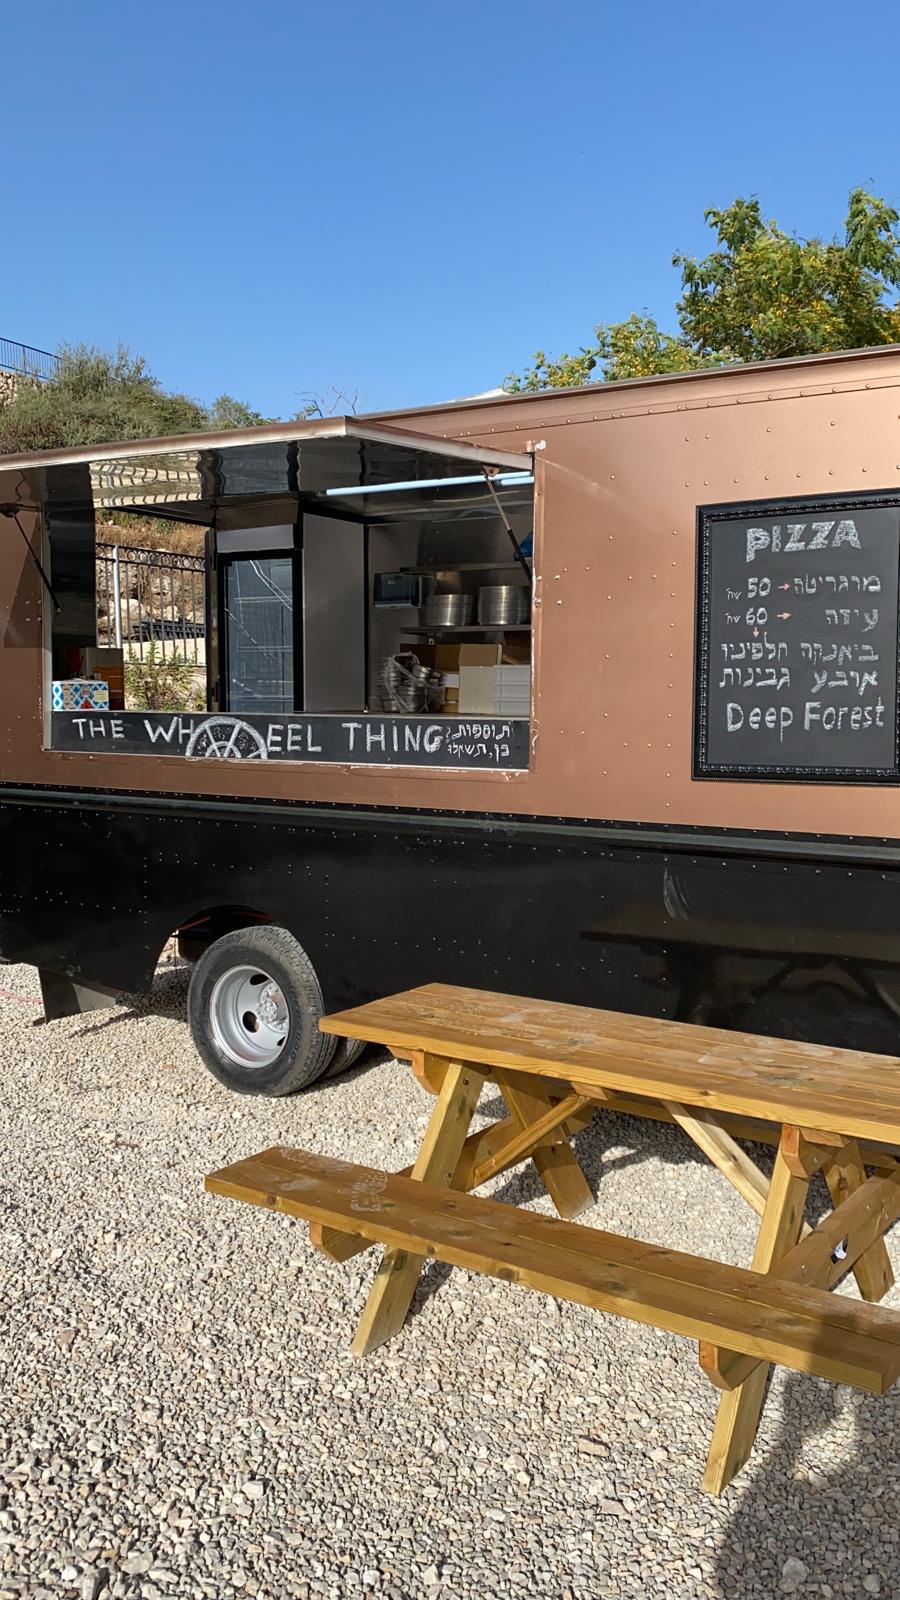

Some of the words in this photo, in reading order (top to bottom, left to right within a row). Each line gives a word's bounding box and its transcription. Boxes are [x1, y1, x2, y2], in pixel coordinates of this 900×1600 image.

[746, 519, 862, 563] PIZZA
[747, 577, 772, 599] 50
[794, 572, 881, 595] מרגריטה
[745, 607, 768, 626] 60
[719, 667, 791, 691] גבינות
[811, 670, 879, 696] ארבע
[726, 702, 794, 743] Deep
[804, 697, 885, 731] Forest
[72, 718, 126, 740] THE
[341, 722, 444, 754] THING
[447, 742, 487, 759] תשאלו
